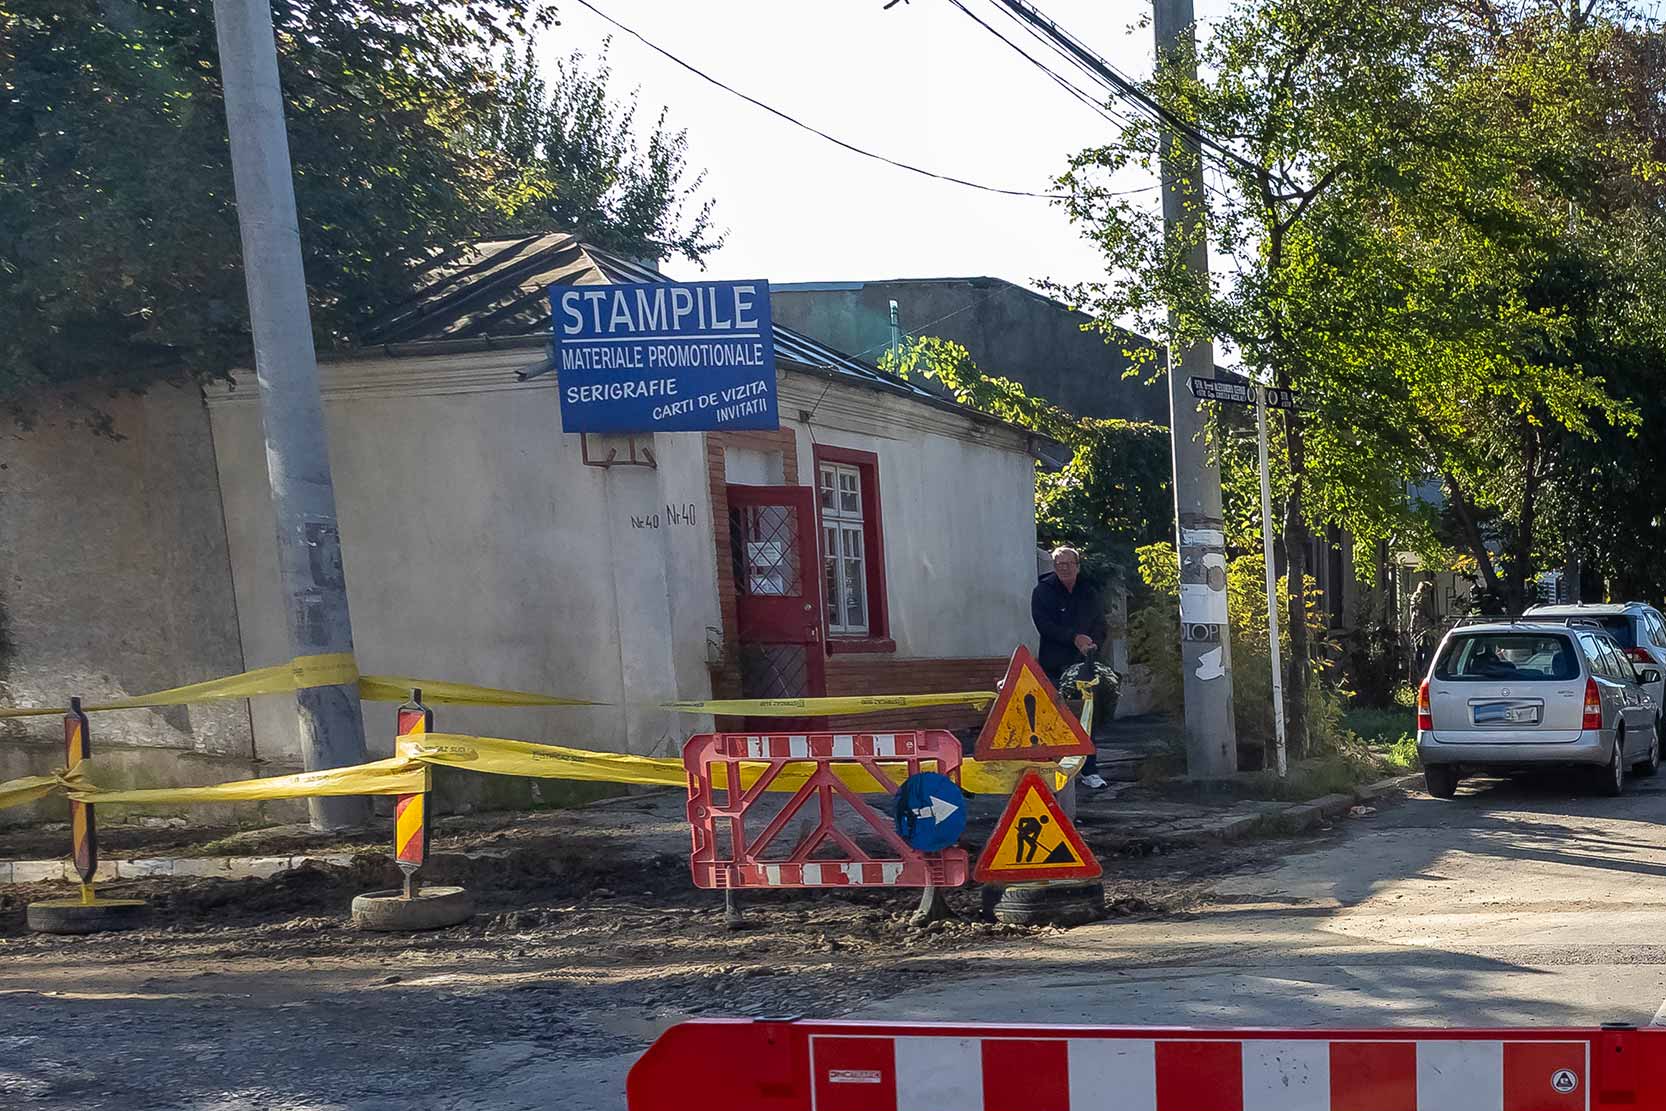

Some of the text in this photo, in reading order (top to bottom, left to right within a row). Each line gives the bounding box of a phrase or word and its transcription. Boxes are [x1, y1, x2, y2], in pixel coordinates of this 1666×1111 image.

[561, 286, 759, 333] STAMPILE
[561, 343, 764, 370] MATERIALE PROMOTIONALE
[567, 378, 678, 404] SERIGRAFIE
[652, 379, 768, 420] CARTI DE VIZITA
[716, 398, 768, 423] INVITATII
